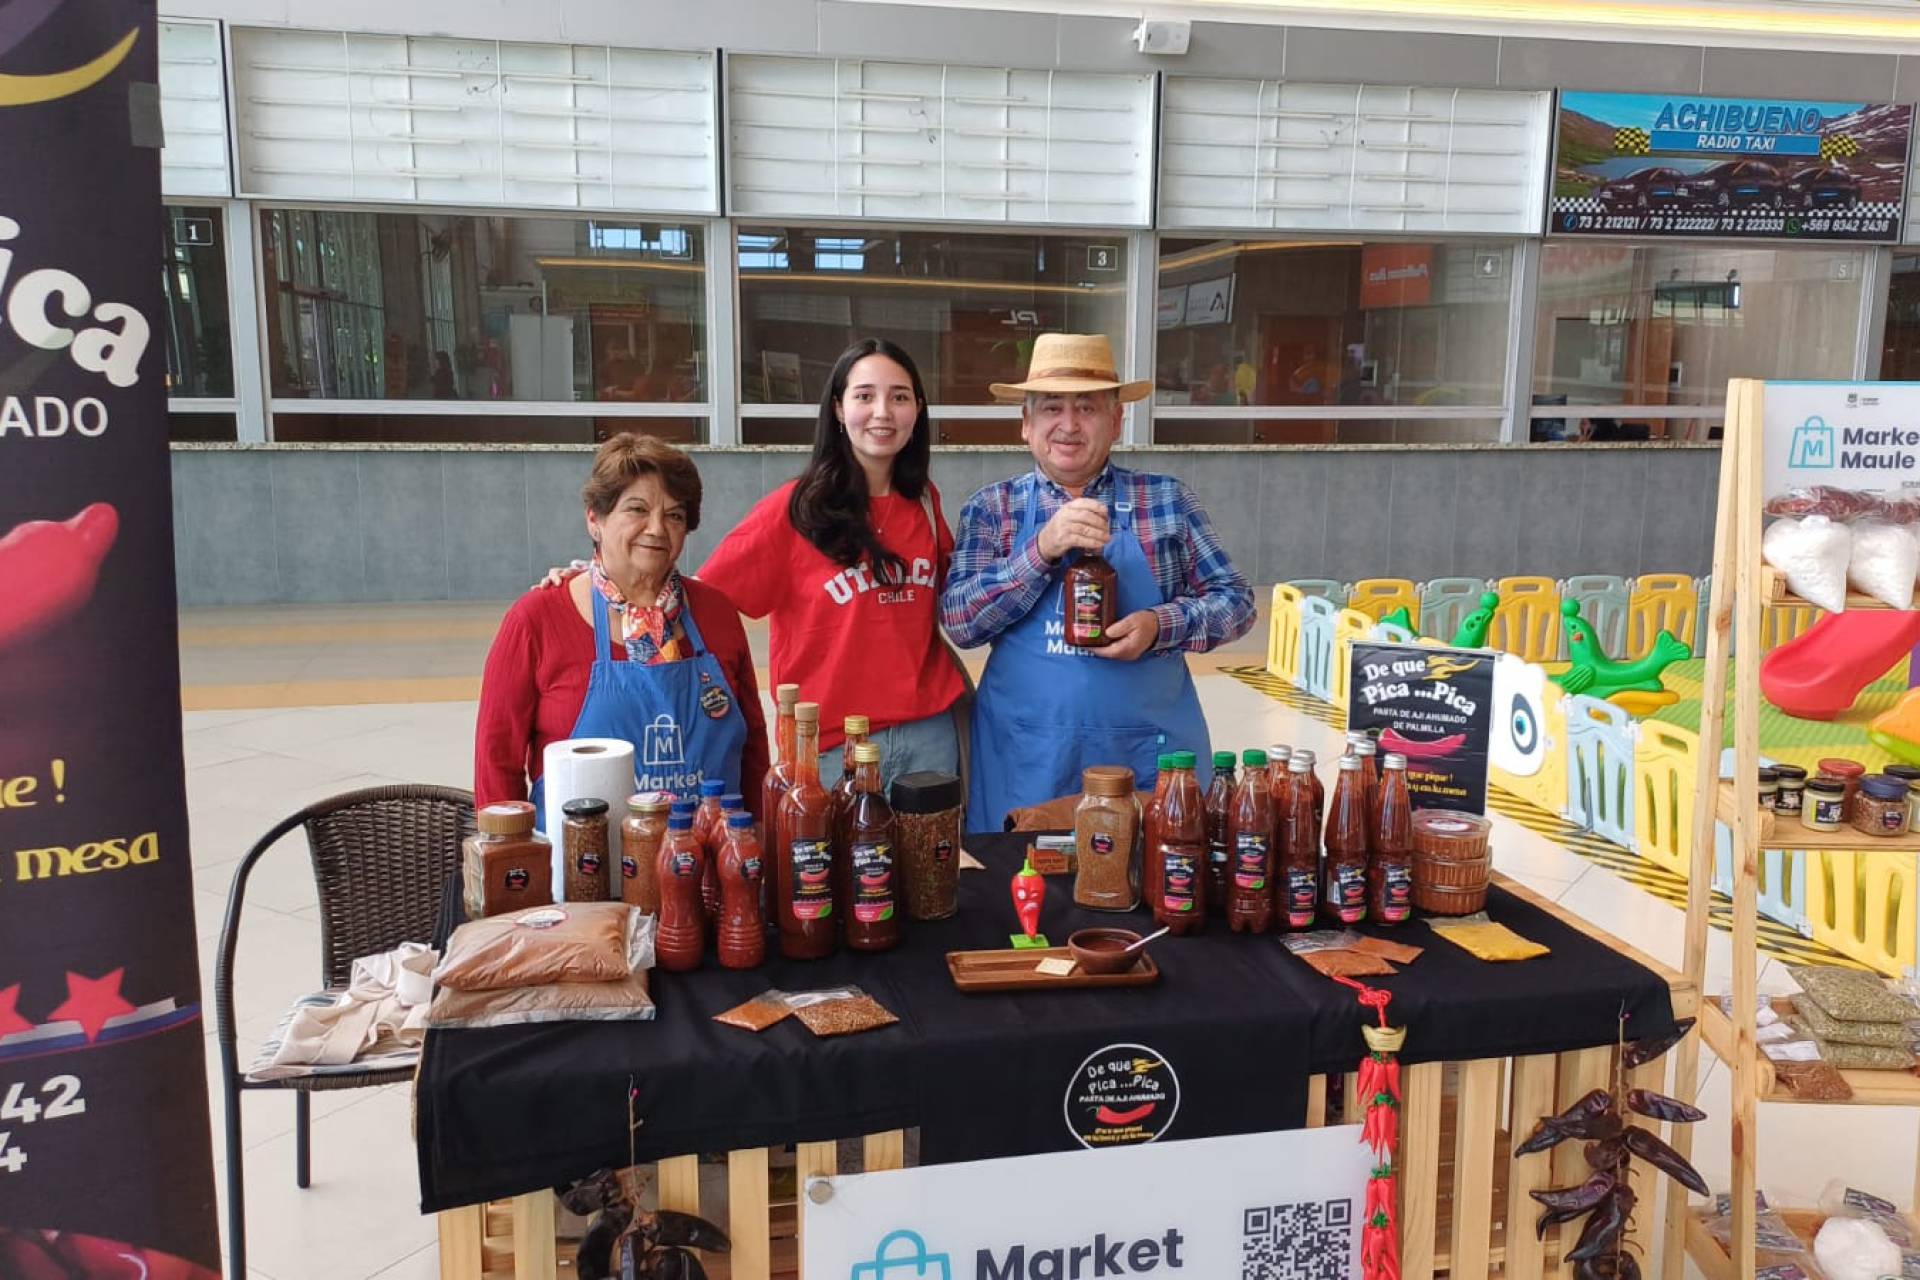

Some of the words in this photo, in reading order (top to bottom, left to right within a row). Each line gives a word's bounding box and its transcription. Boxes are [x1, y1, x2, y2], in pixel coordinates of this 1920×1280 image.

[1654, 102, 1823, 134] ACHIBUENO
[1697, 135, 1742, 149] RADIO
[1745, 137, 1776, 150] TAXI
[189, 224, 198, 240] 1
[1579, 216, 1592, 228] 73
[1595, 217, 1602, 229] 2
[1650, 217, 1662, 229] 73
[1665, 218, 1672, 230] 2
[1721, 218, 1734, 230] 73
[1737, 219, 1744, 230] 2
[1098, 251, 1107, 266] 3
[1840, 451, 1916, 469] Maule
[878, 589, 916, 604] CHILE
[1363, 663, 1389, 681] De
[1392, 660, 1425, 676] que
[1361, 683, 1410, 704] Pica
[1373, 707, 1398, 717] PASTA
[1400, 709, 1410, 718] DE
[1425, 712, 1467, 724] AHUMADO
[1393, 720, 1404, 730] DE
[1406, 722, 1446, 734] PALMILLA
[15, 832, 160, 880] mesa
[1088, 1064, 1105, 1078] De
[1108, 1060, 1131, 1072] que
[1, 1074, 86, 1123] 42
[976, 1228, 1184, 1280] Market
